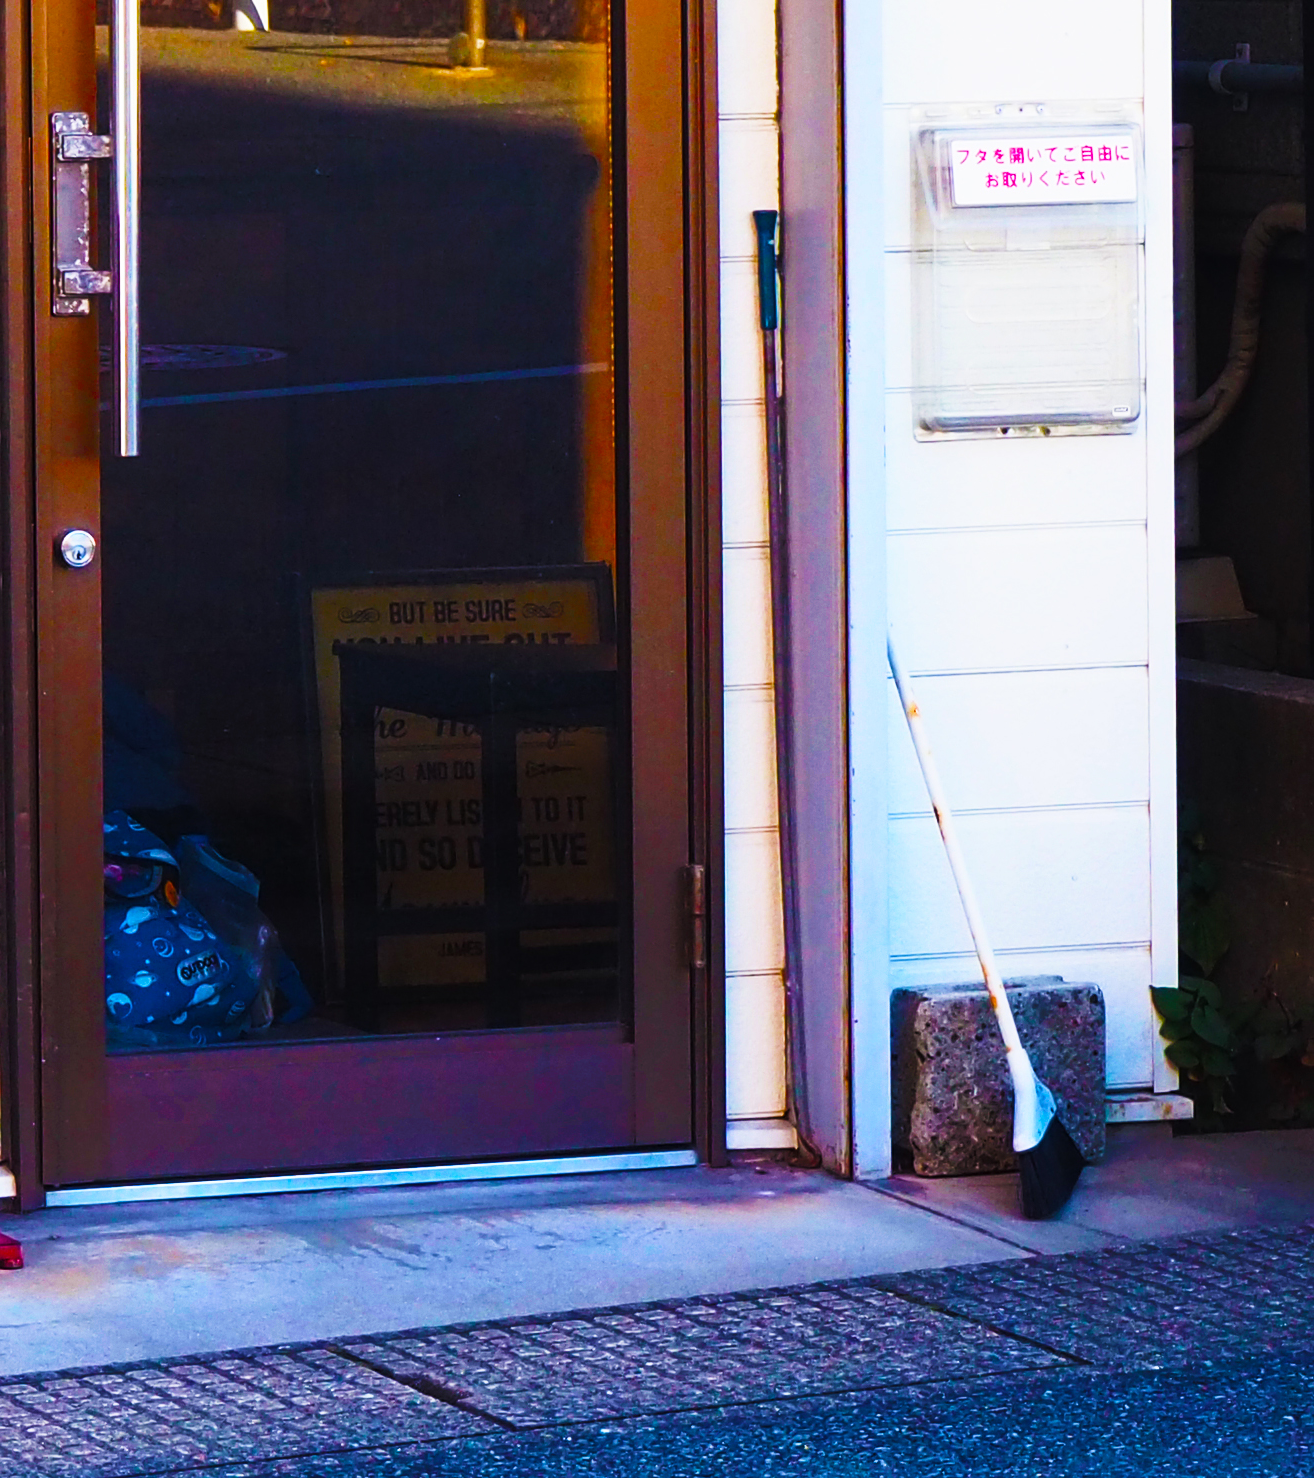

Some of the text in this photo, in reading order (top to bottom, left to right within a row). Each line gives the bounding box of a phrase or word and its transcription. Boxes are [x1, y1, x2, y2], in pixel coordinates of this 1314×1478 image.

[956, 145, 1130, 165] フタを開いてご自由に
[984, 170, 1106, 189] お取りください
[389, 599, 517, 625] BUT BE SURE
[416, 761, 475, 780] AND DO
[375, 799, 439, 828] ERELY
[532, 796, 559, 824] TO
[565, 795, 587, 822] IT
[418, 835, 457, 870] SO
